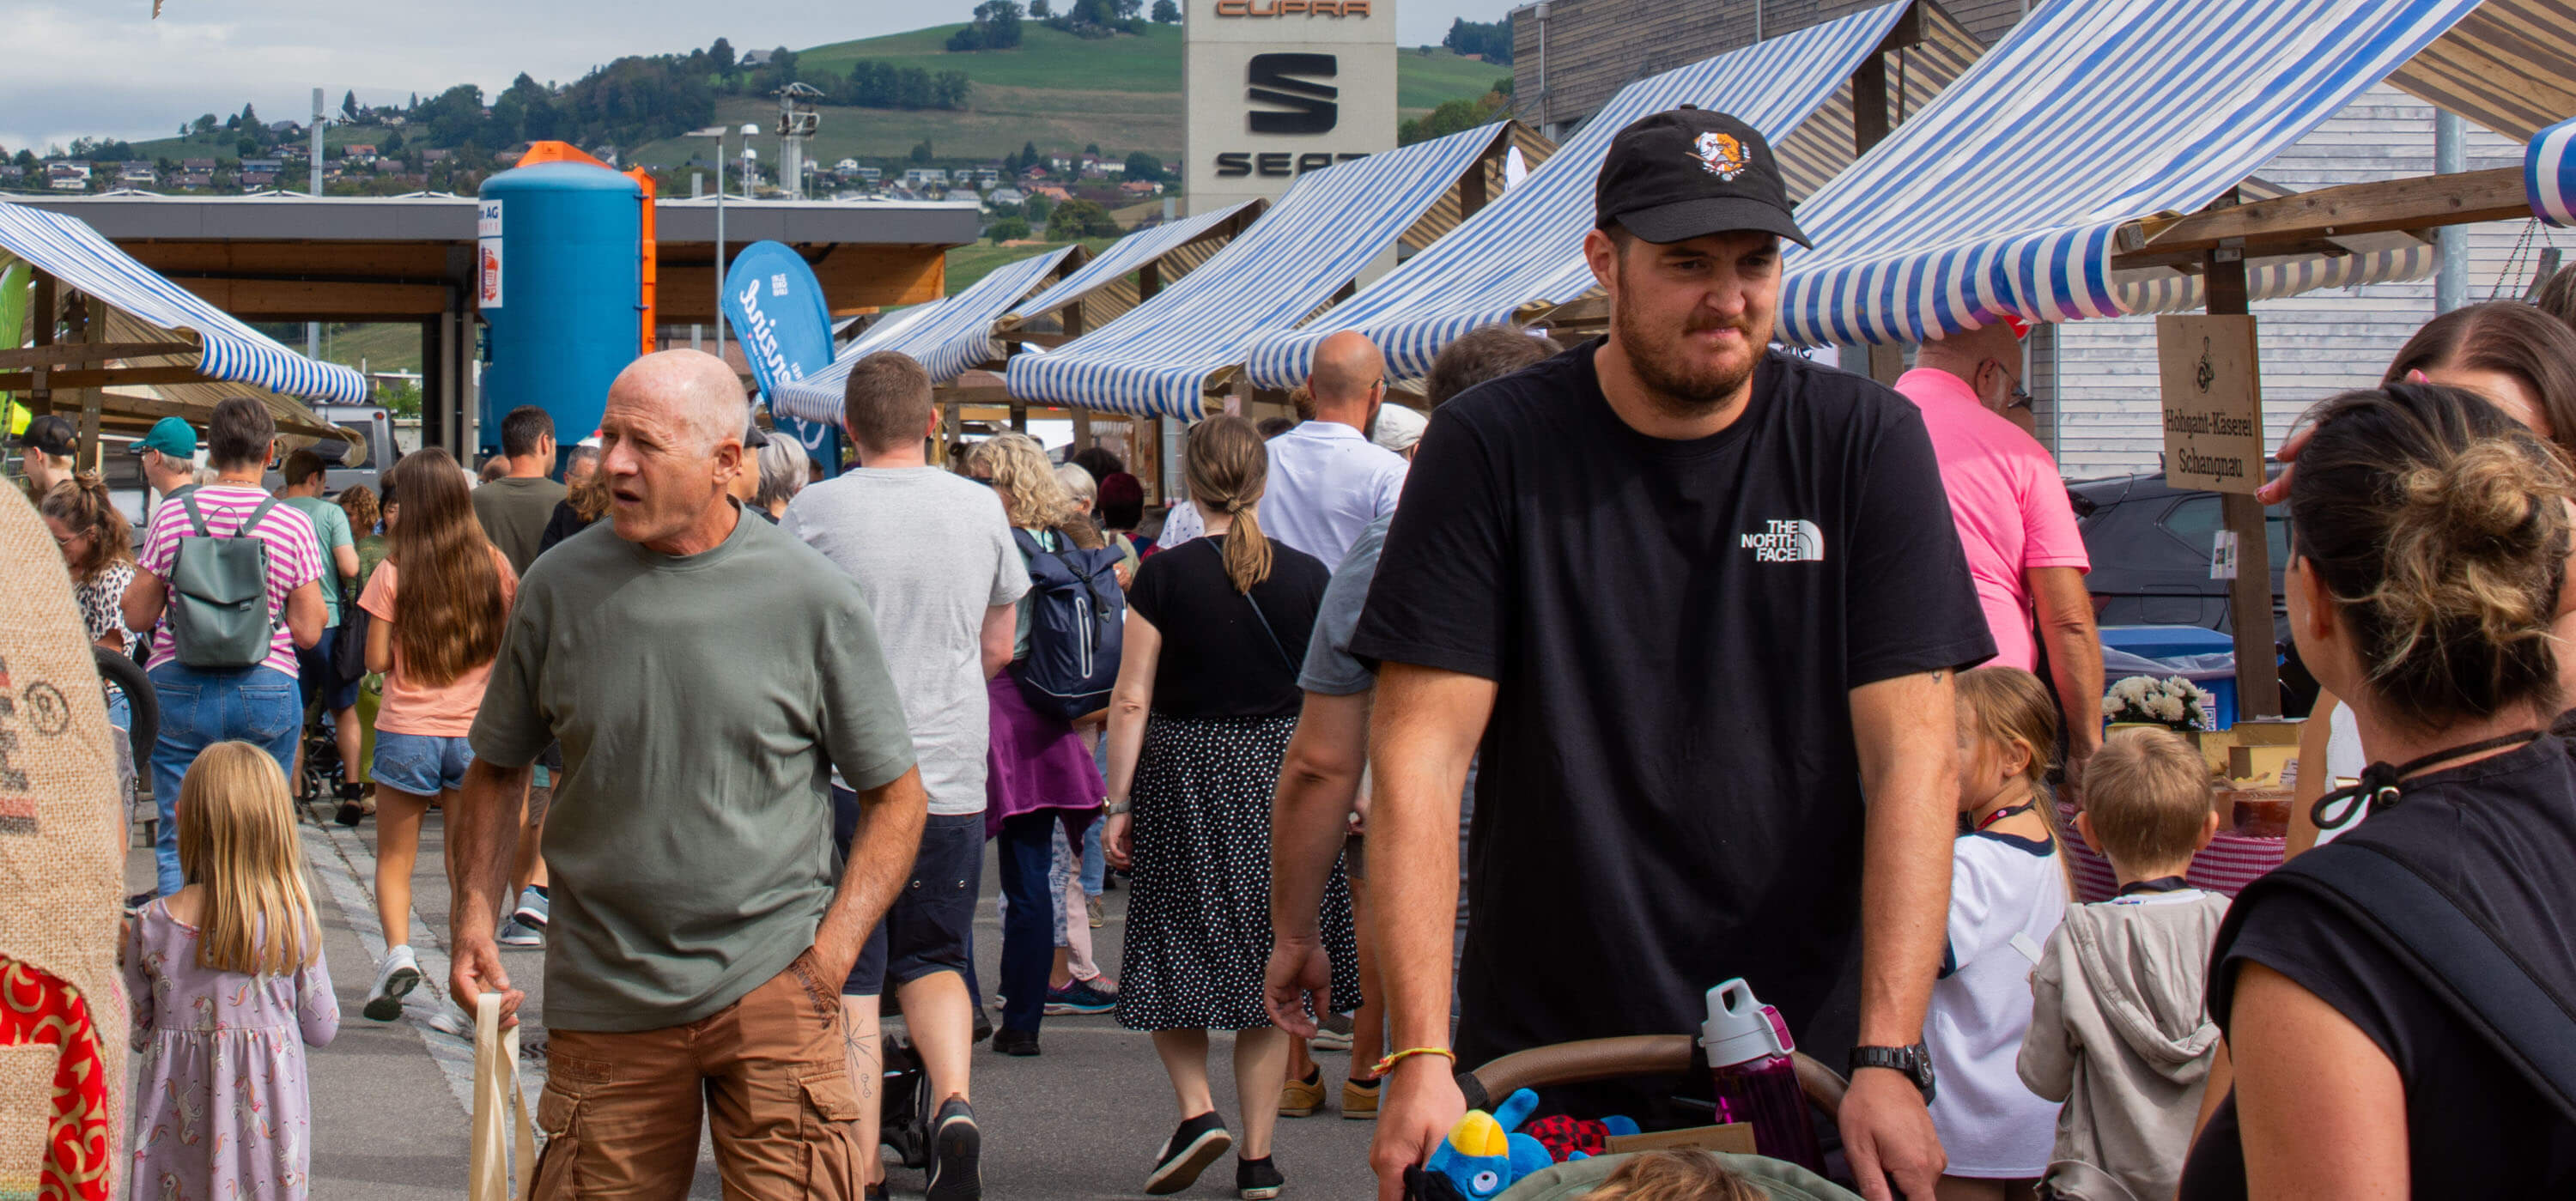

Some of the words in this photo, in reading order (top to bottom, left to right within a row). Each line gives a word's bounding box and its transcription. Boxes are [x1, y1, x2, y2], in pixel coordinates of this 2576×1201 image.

[1218, 0, 1370, 16] CUPRA
[486, 206, 499, 219] AG
[2165, 409, 2252, 439] Hohgant-Käserei
[2178, 447, 2244, 482] Schangnau
[1766, 519, 1799, 534] THE
[1741, 533, 1799, 549] NORTH
[1756, 547, 1799, 562] FACE
